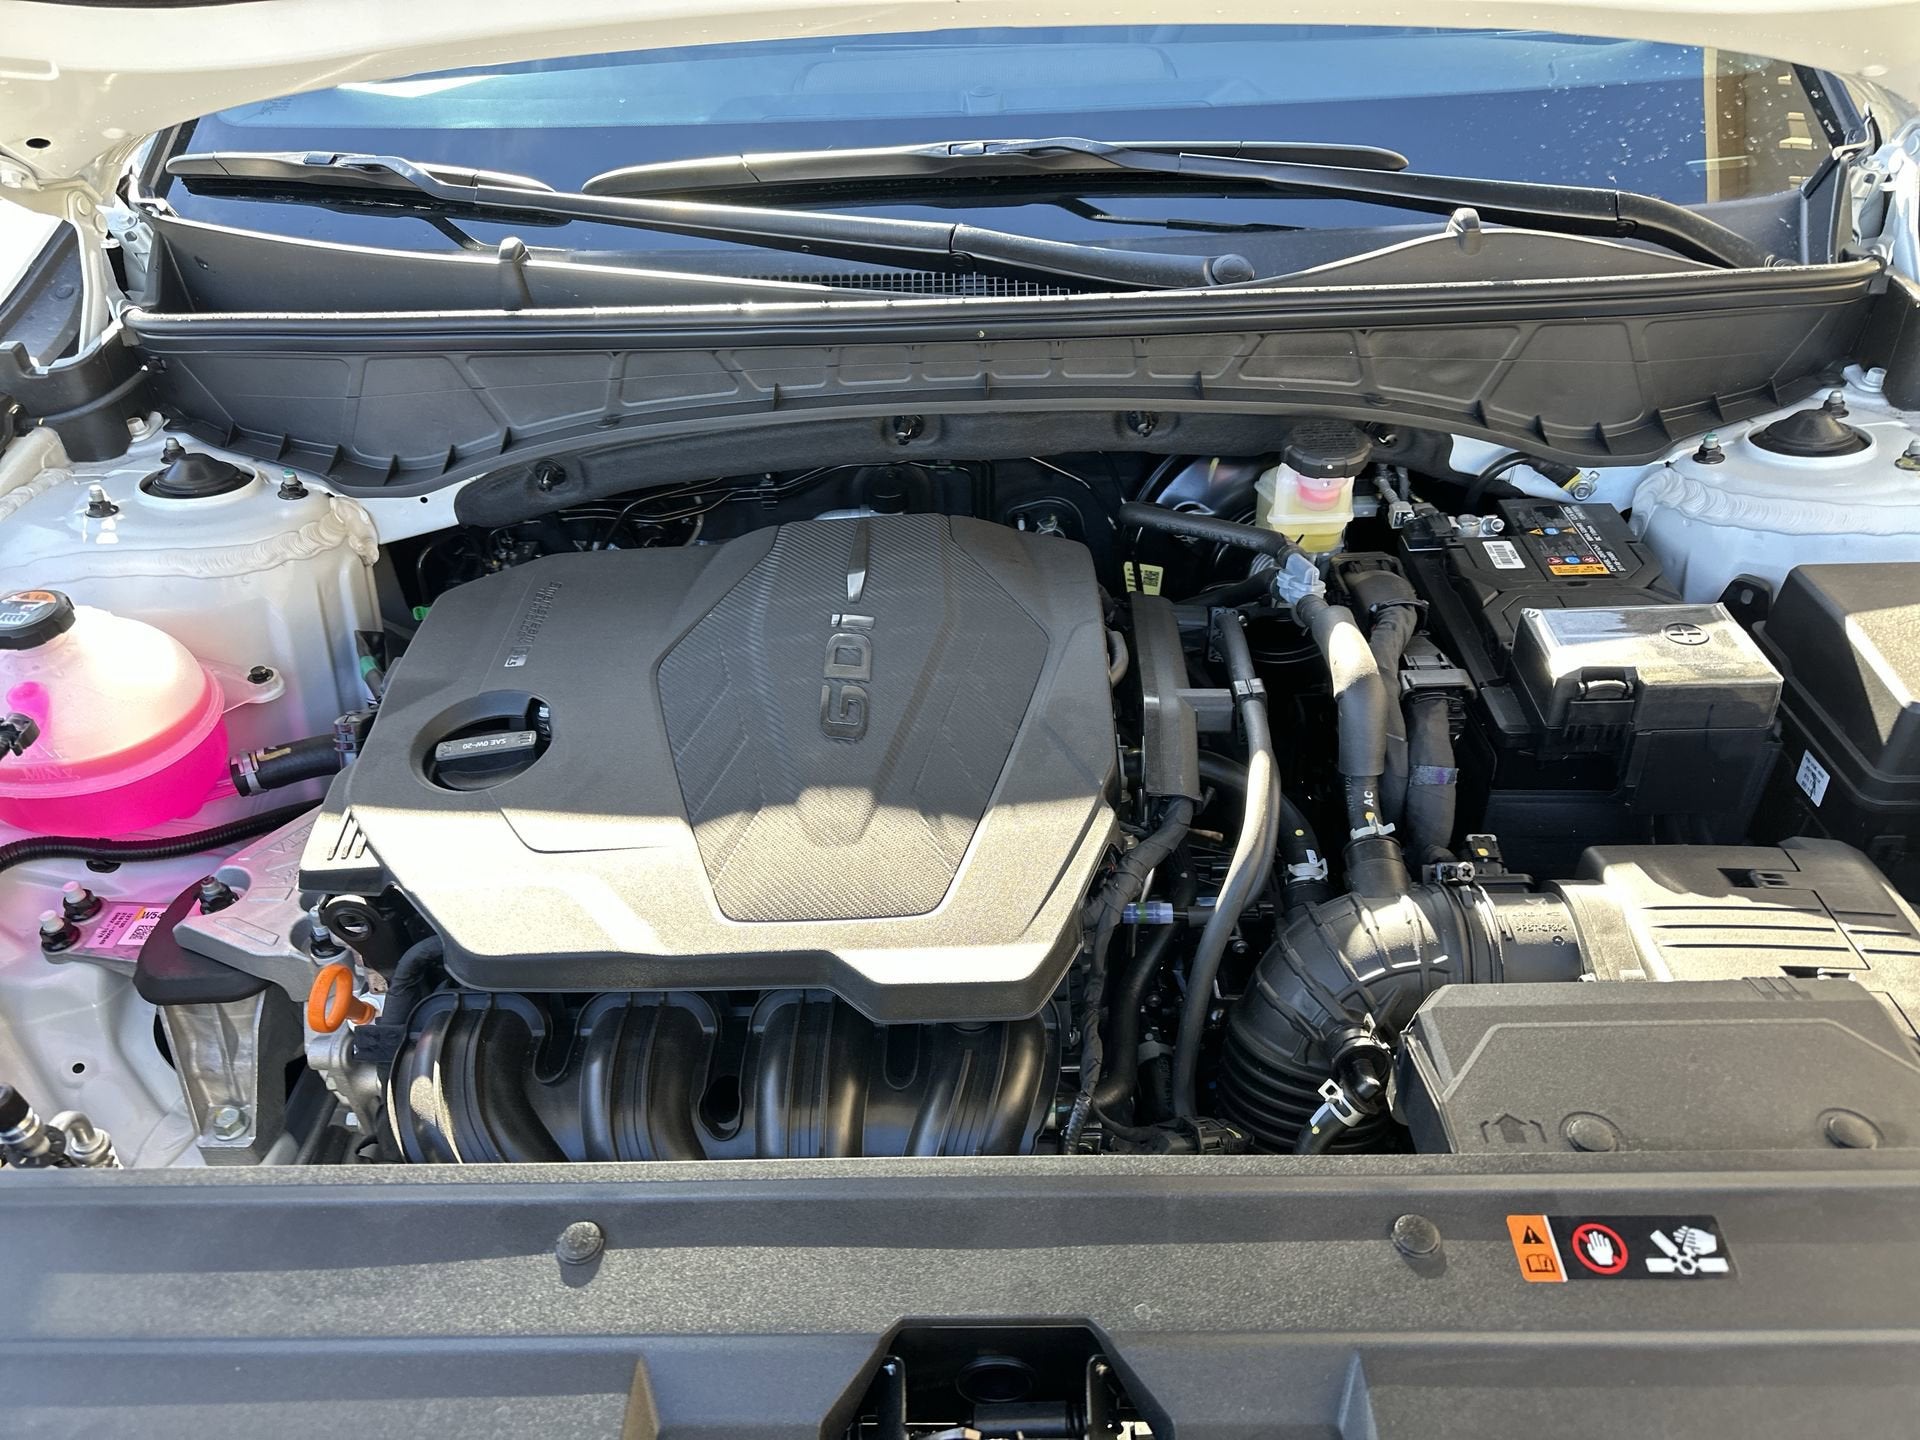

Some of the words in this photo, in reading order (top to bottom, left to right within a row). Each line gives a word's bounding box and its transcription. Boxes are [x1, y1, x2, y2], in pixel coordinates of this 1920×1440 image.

[820, 613, 875, 741] GDi
[490, 738, 507, 746] SAE
[1363, 790, 1374, 807] AC
